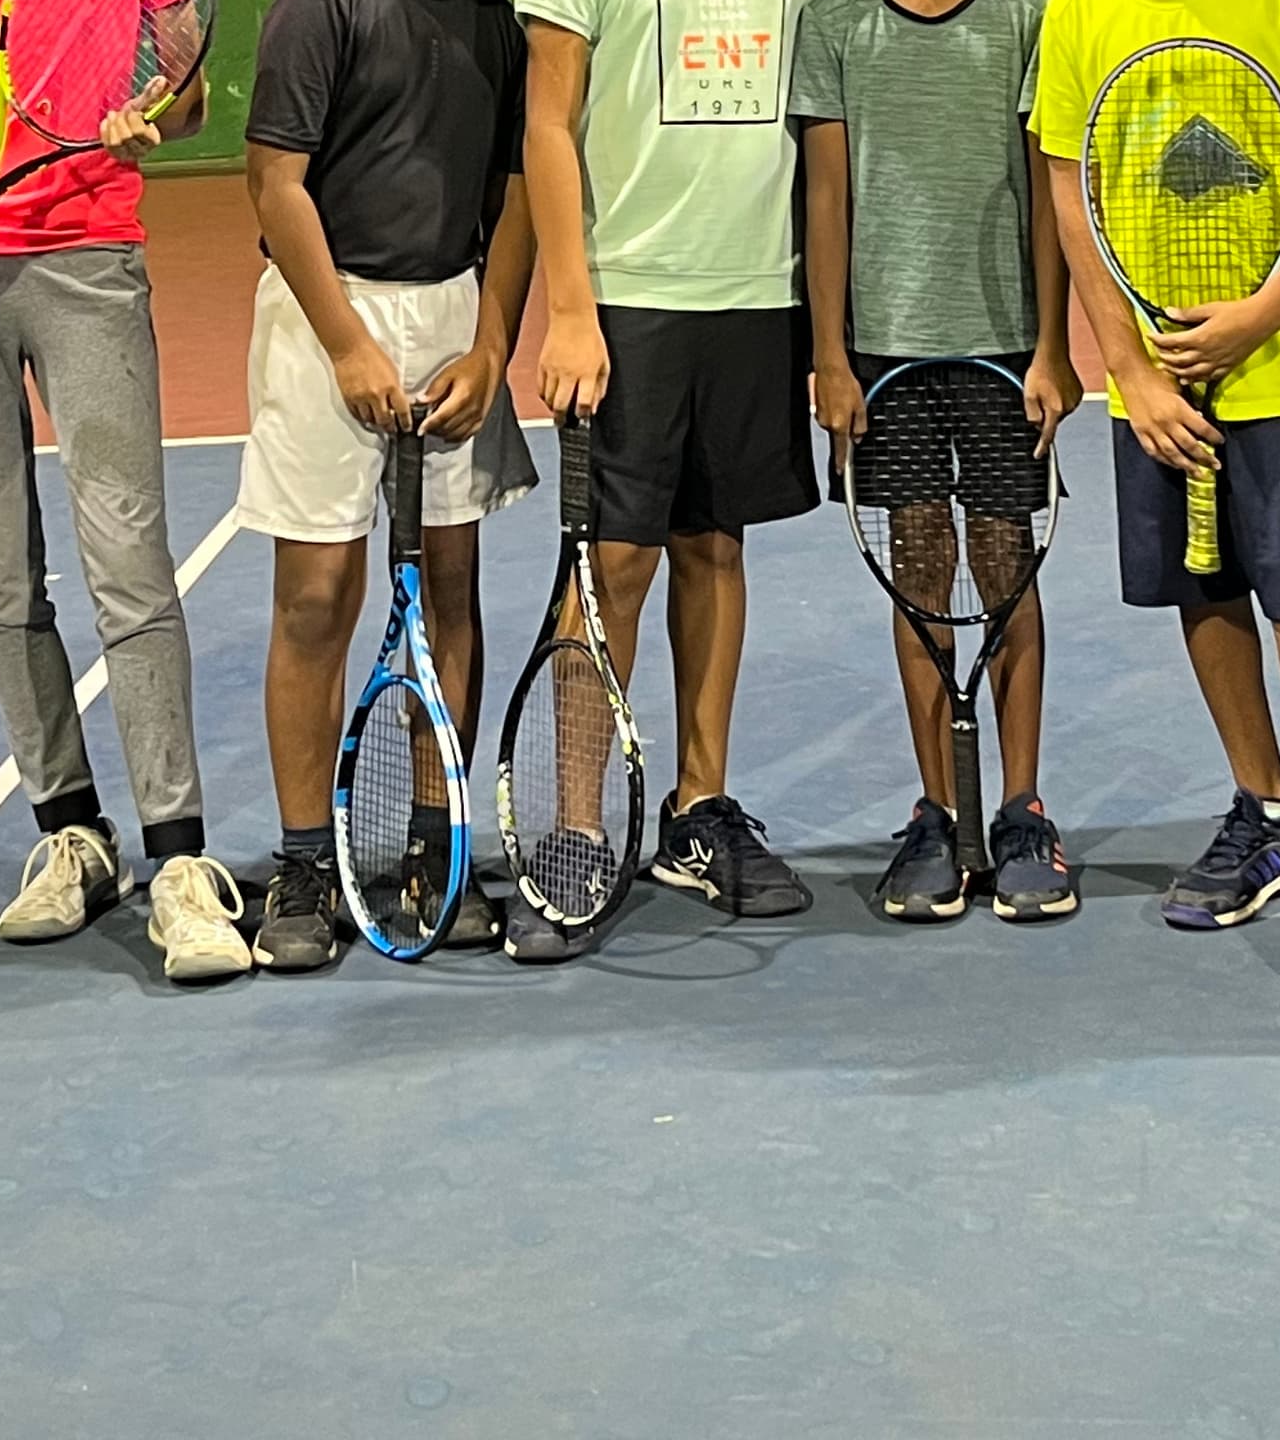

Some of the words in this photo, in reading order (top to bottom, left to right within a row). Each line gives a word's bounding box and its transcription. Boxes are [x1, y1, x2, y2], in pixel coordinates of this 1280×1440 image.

[683, 34, 771, 69] ENT
[690, 100, 761, 115] 1973
[576, 541, 606, 642] HEAD
